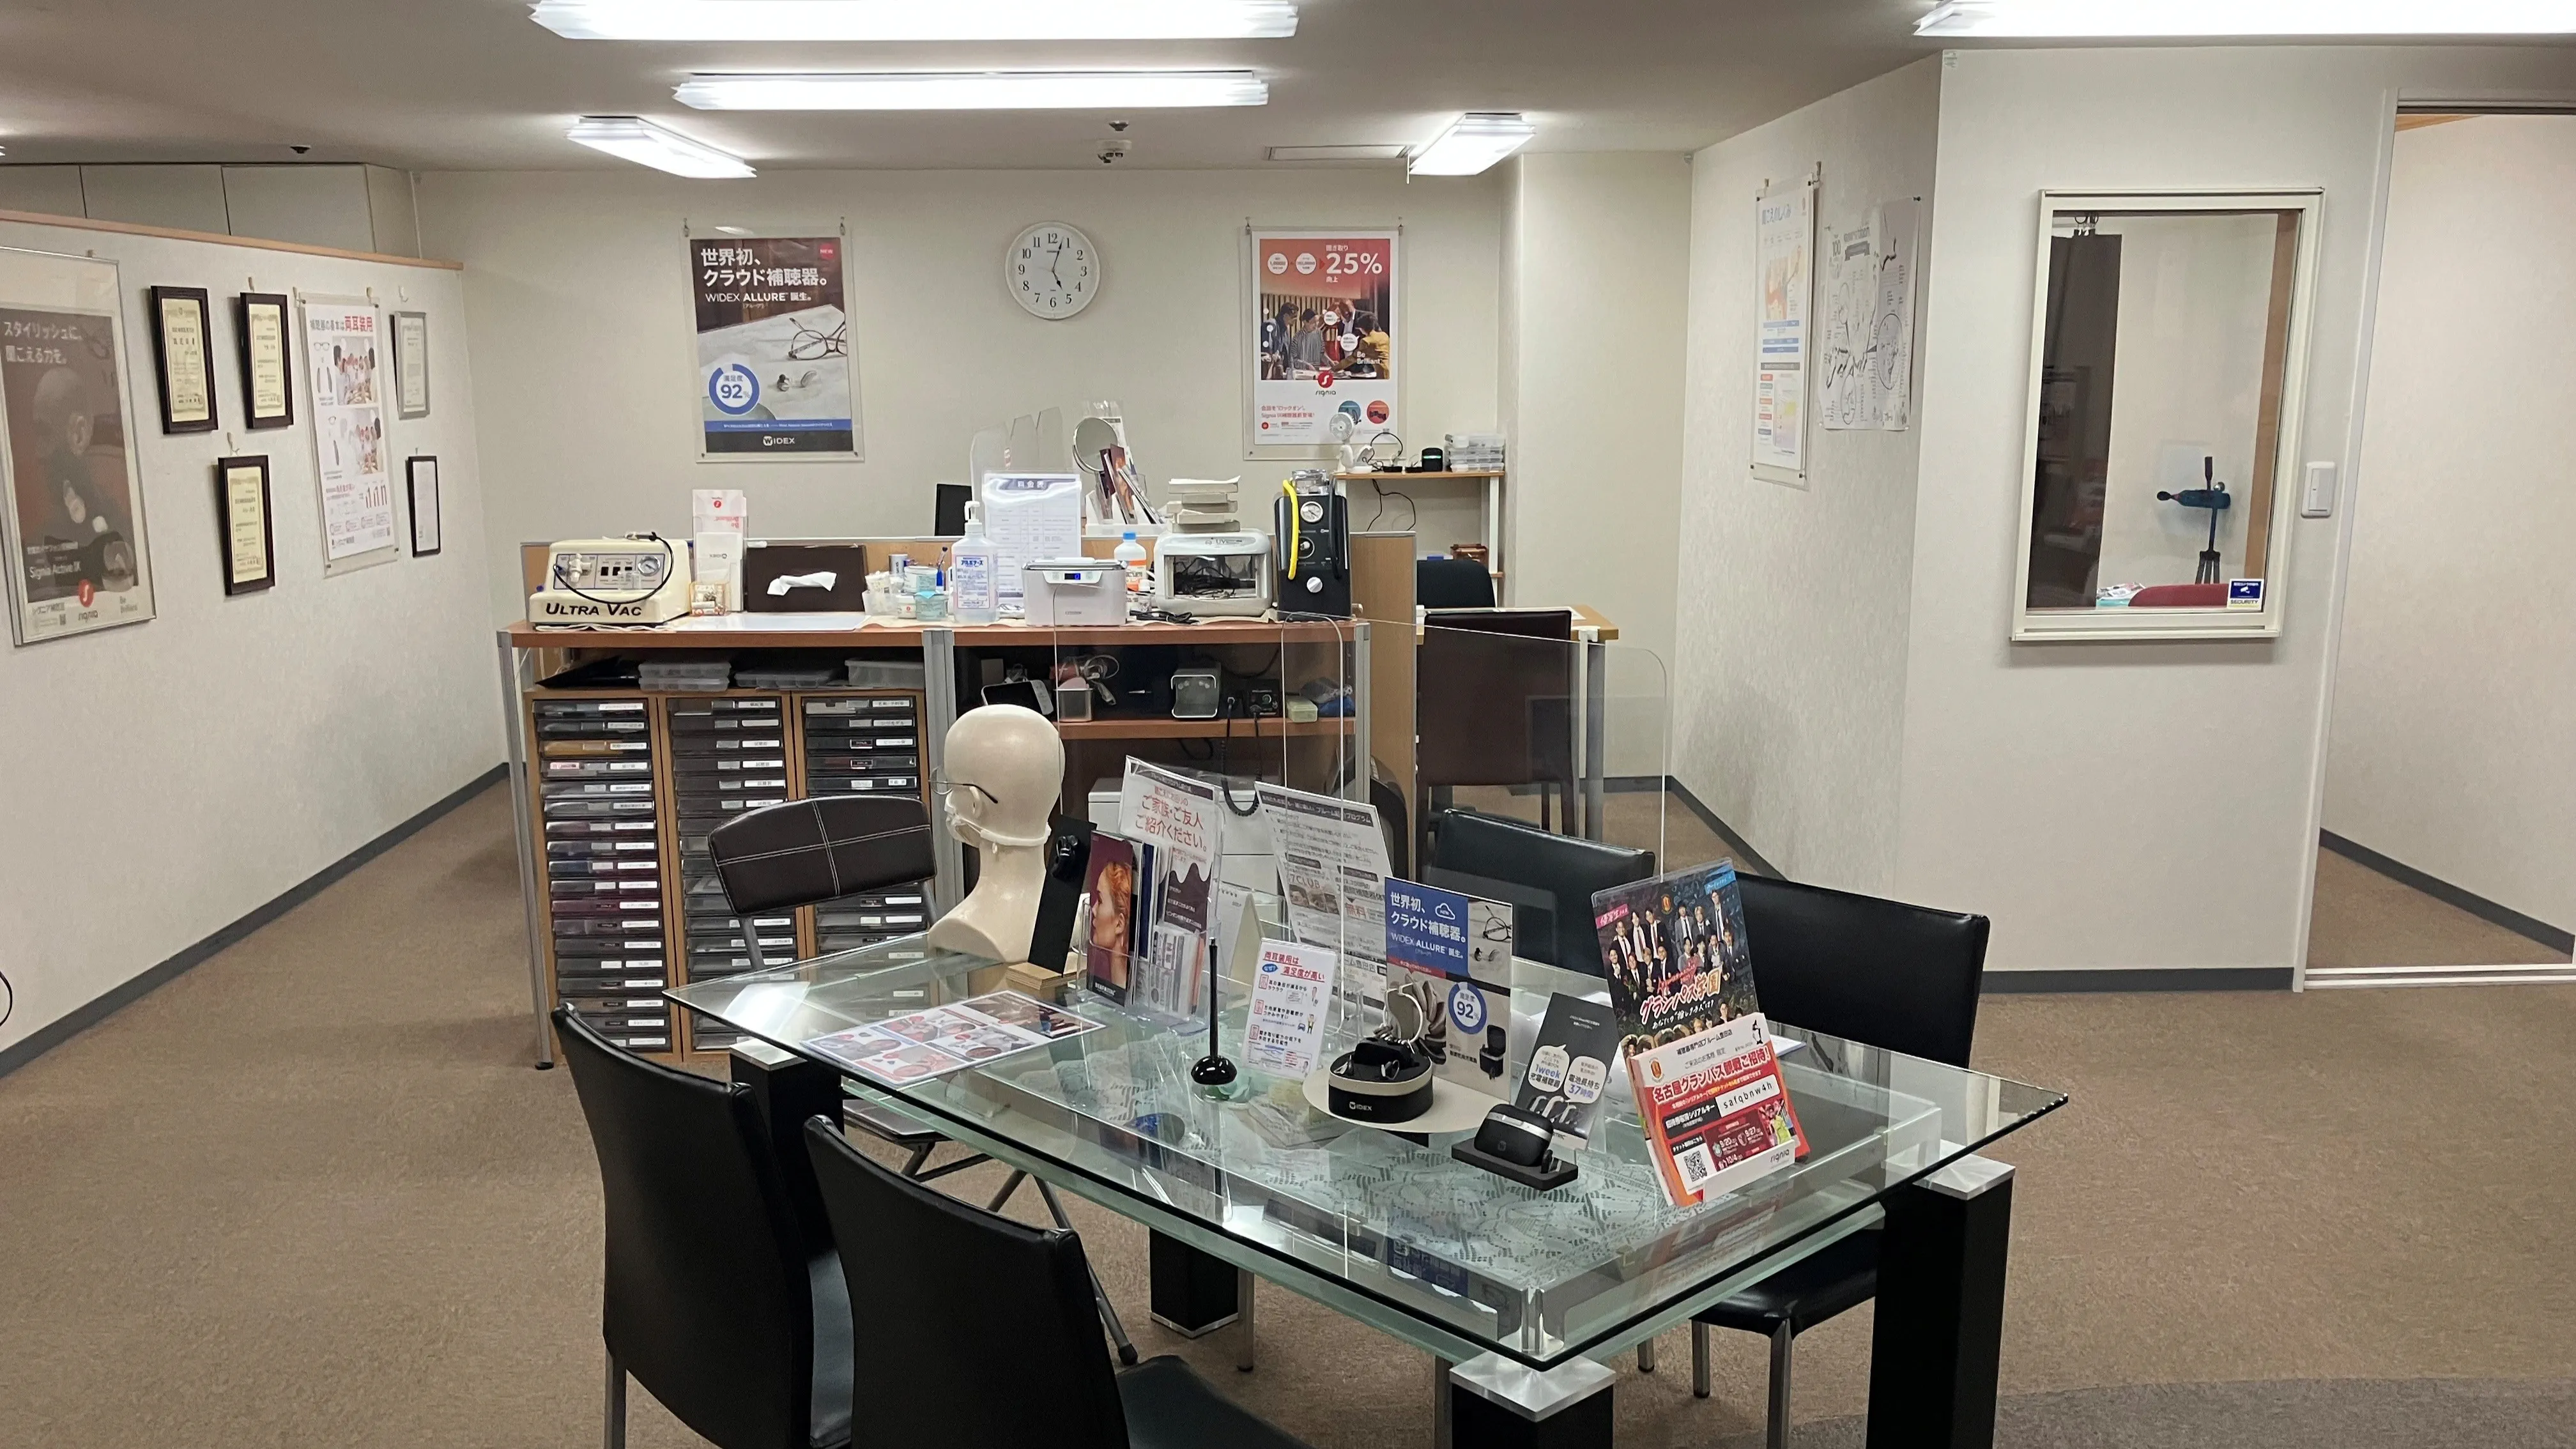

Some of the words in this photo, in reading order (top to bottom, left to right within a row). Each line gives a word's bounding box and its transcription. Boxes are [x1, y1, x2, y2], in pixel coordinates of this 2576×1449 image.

[1033, 236, 1041, 247] 11
[1048, 233, 1058, 244] 12
[1066, 238, 1071, 248] 1
[701, 248, 761, 266] 世界初、
[1022, 249, 1031, 259] 10
[1077, 250, 1084, 261] 2
[1018, 264, 1025, 275] 9
[1326, 252, 1383, 275] 25%
[703, 268, 827, 287] クラウド補聴器。
[1080, 266, 1087, 277] 3
[1023, 280, 1030, 291] 8
[1075, 282, 1082, 292] 4
[705, 293, 740, 302] WIDEX
[743, 292, 786, 302] ALLURE
[790, 292, 811, 302] 誕生。
[1034, 293, 1040, 303] 7
[1050, 297, 1057, 308] 6
[1066, 294, 1072, 304] 5
[763, 435, 795, 447] WIDEX
[1142, 794, 1204, 831] ご家族・ご友人
[1135, 814, 1207, 852] ご紹介ください。
[1289, 873, 1321, 889] 7CLUB
[1390, 891, 1425, 914] 世界初、
[1345, 902, 1366, 918] 無料
[1391, 910, 1466, 943] クラウド補聴器。
[1391, 932, 1415, 946] WIDEX
[1416, 939, 1446, 954] ALLURE
[1265, 951, 1300, 965] 両耳装用は
[1283, 966, 1325, 980] 満足度が高い
[1640, 967, 1721, 1025] グランパス学園
[1535, 1064, 1561, 1079] 1week
[1531, 1072, 1561, 1089] 充電補聴器
[1568, 1074, 1600, 1090] 電池長持ち
[1568, 1084, 1595, 1099] 37時間
[1723, 1081, 1772, 1109] safqbnw4h
[1349, 1101, 1372, 1112] WIDEX
[1769, 1149, 1790, 1163] signia
